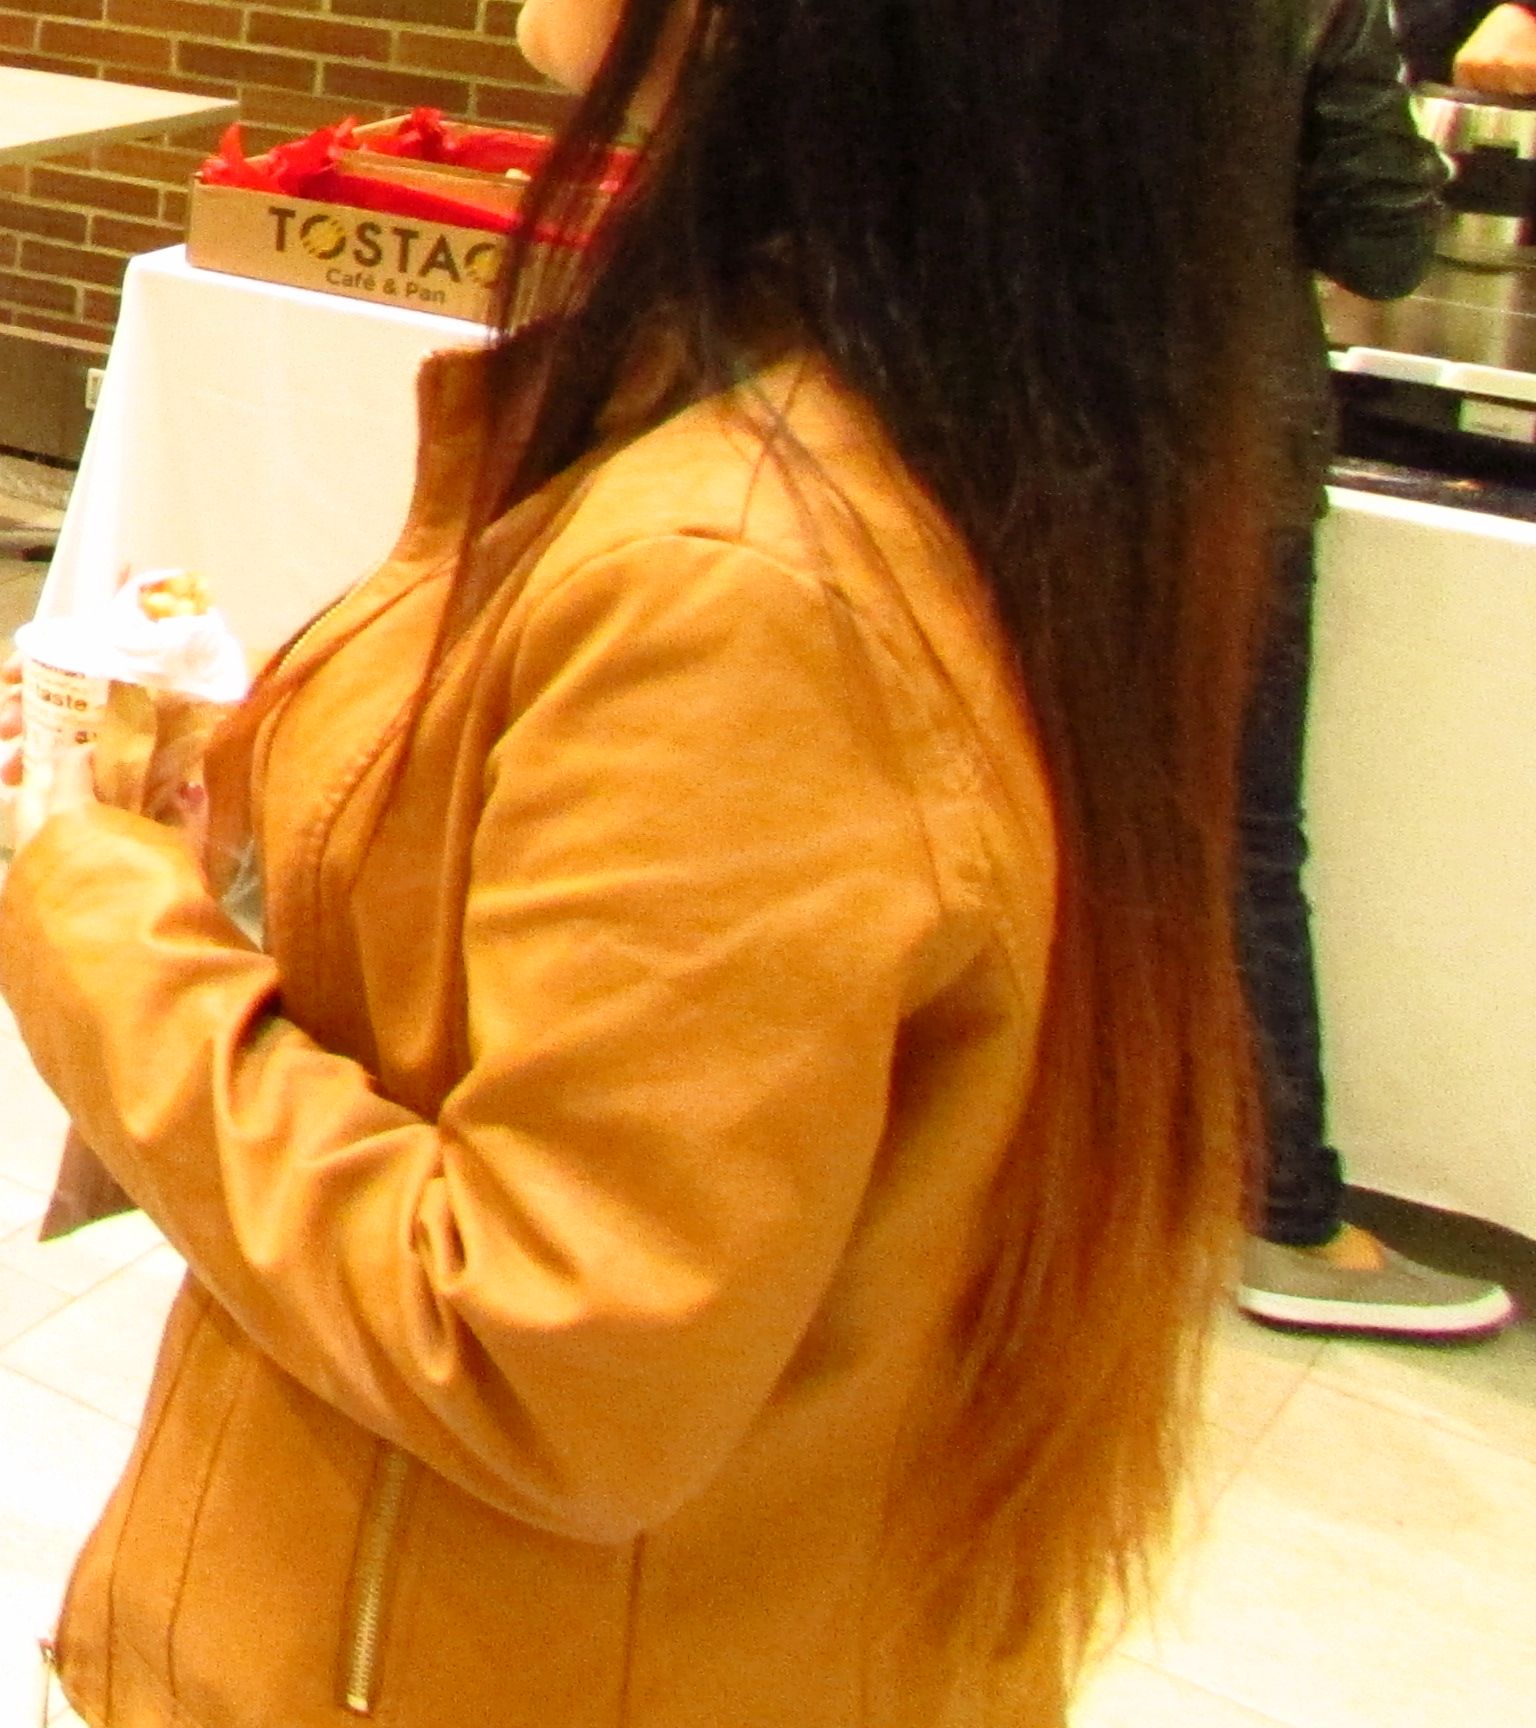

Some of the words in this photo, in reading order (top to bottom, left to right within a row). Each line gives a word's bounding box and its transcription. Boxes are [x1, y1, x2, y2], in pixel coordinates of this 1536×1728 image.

[326, 268, 377, 292] Café
[382, 278, 397, 294] &
[405, 281, 446, 304] Pan
